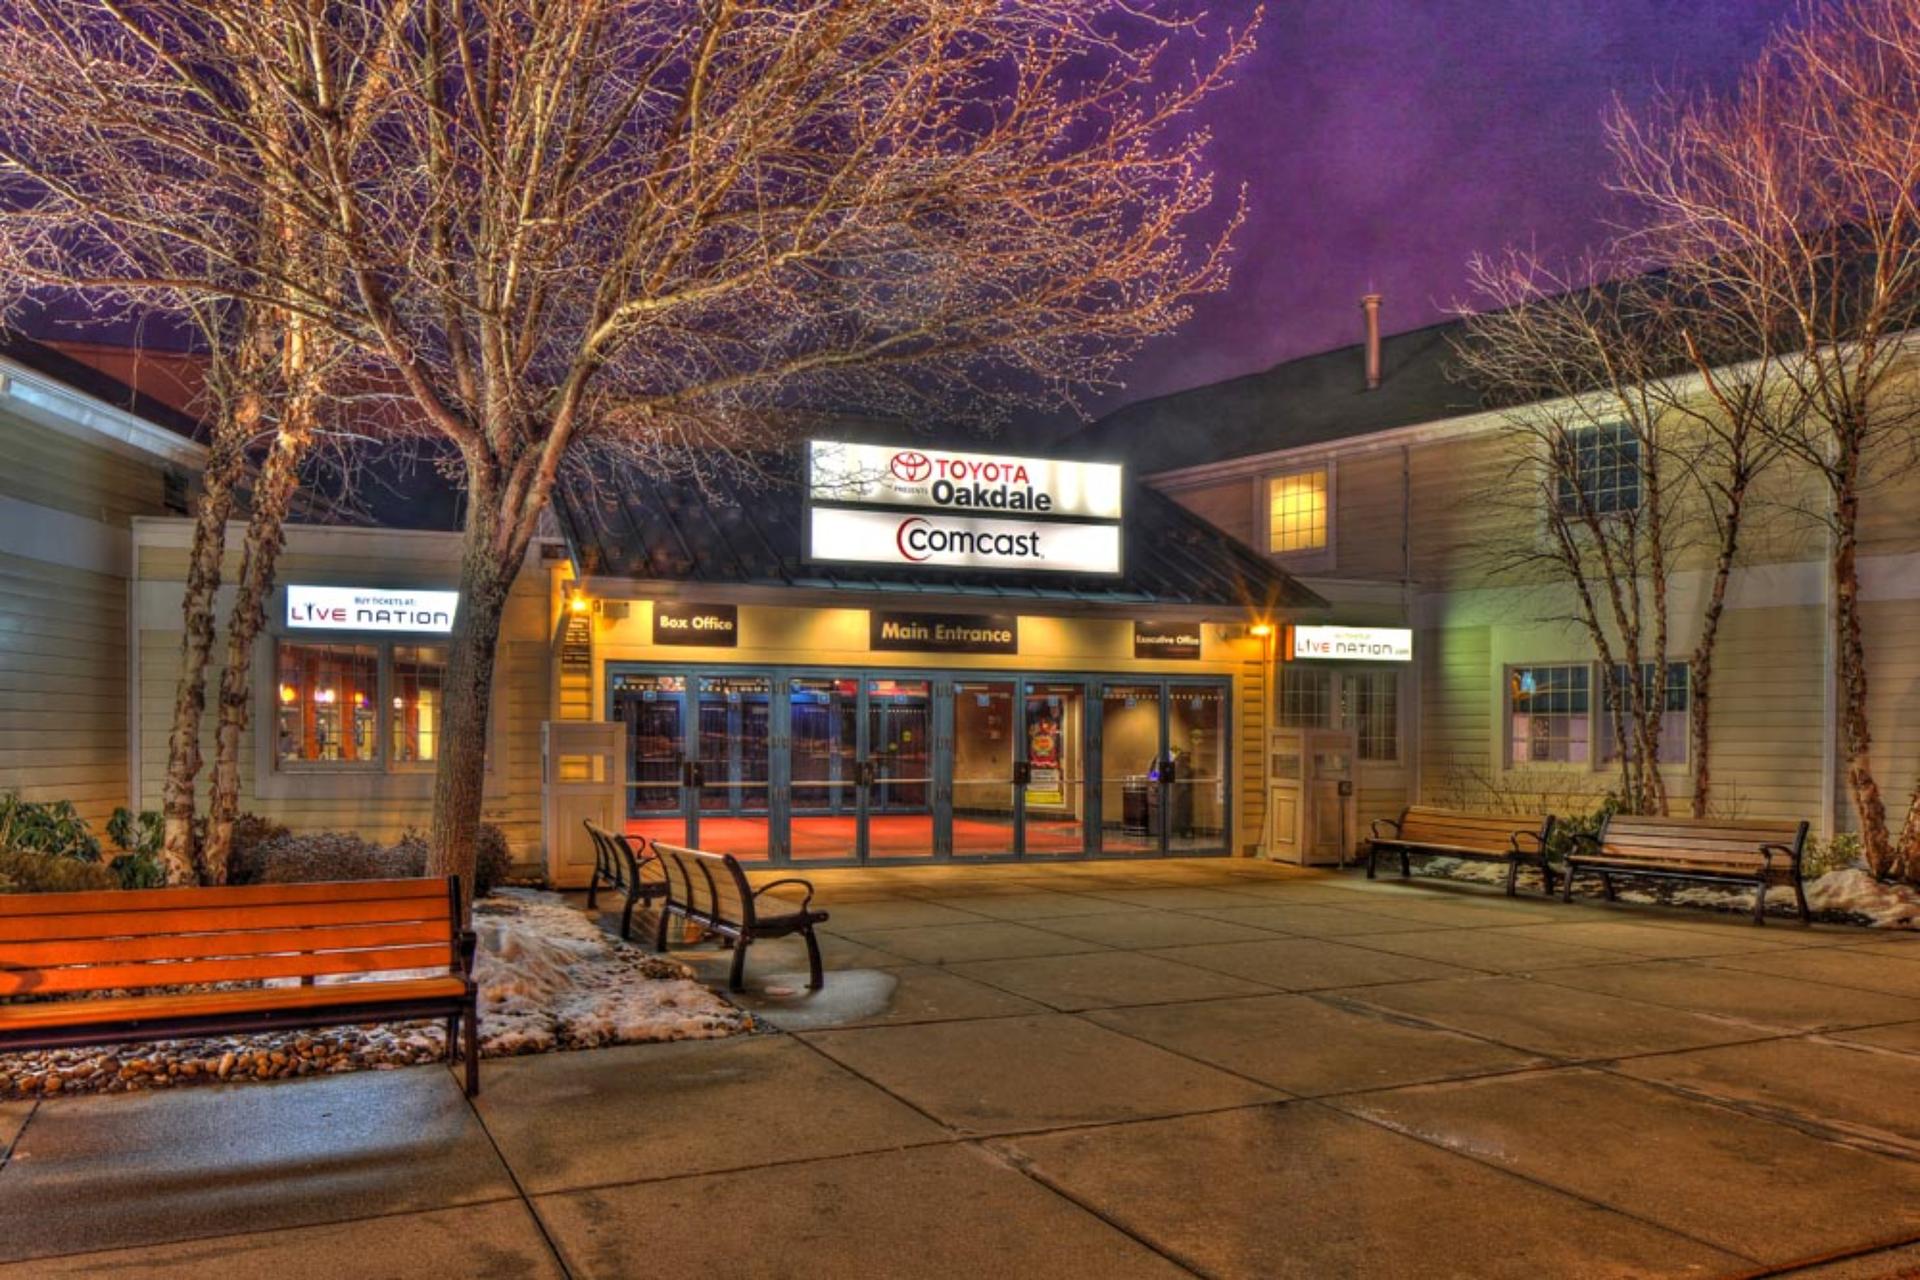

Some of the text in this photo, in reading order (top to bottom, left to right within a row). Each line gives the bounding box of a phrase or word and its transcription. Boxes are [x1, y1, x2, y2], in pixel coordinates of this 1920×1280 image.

[936, 459, 1029, 484] TOYOTA
[931, 479, 1052, 512] Oakdale
[354, 596, 371, 606] BUY
[372, 597, 403, 607] TICKETS
[291, 602, 449, 625] LIVE NATION
[659, 614, 734, 632] Box Office
[881, 620, 1013, 644] Main Entrance
[1176, 634, 1199, 647] Office
[1297, 638, 1331, 654] LIVE
[1336, 641, 1394, 656] NATION
